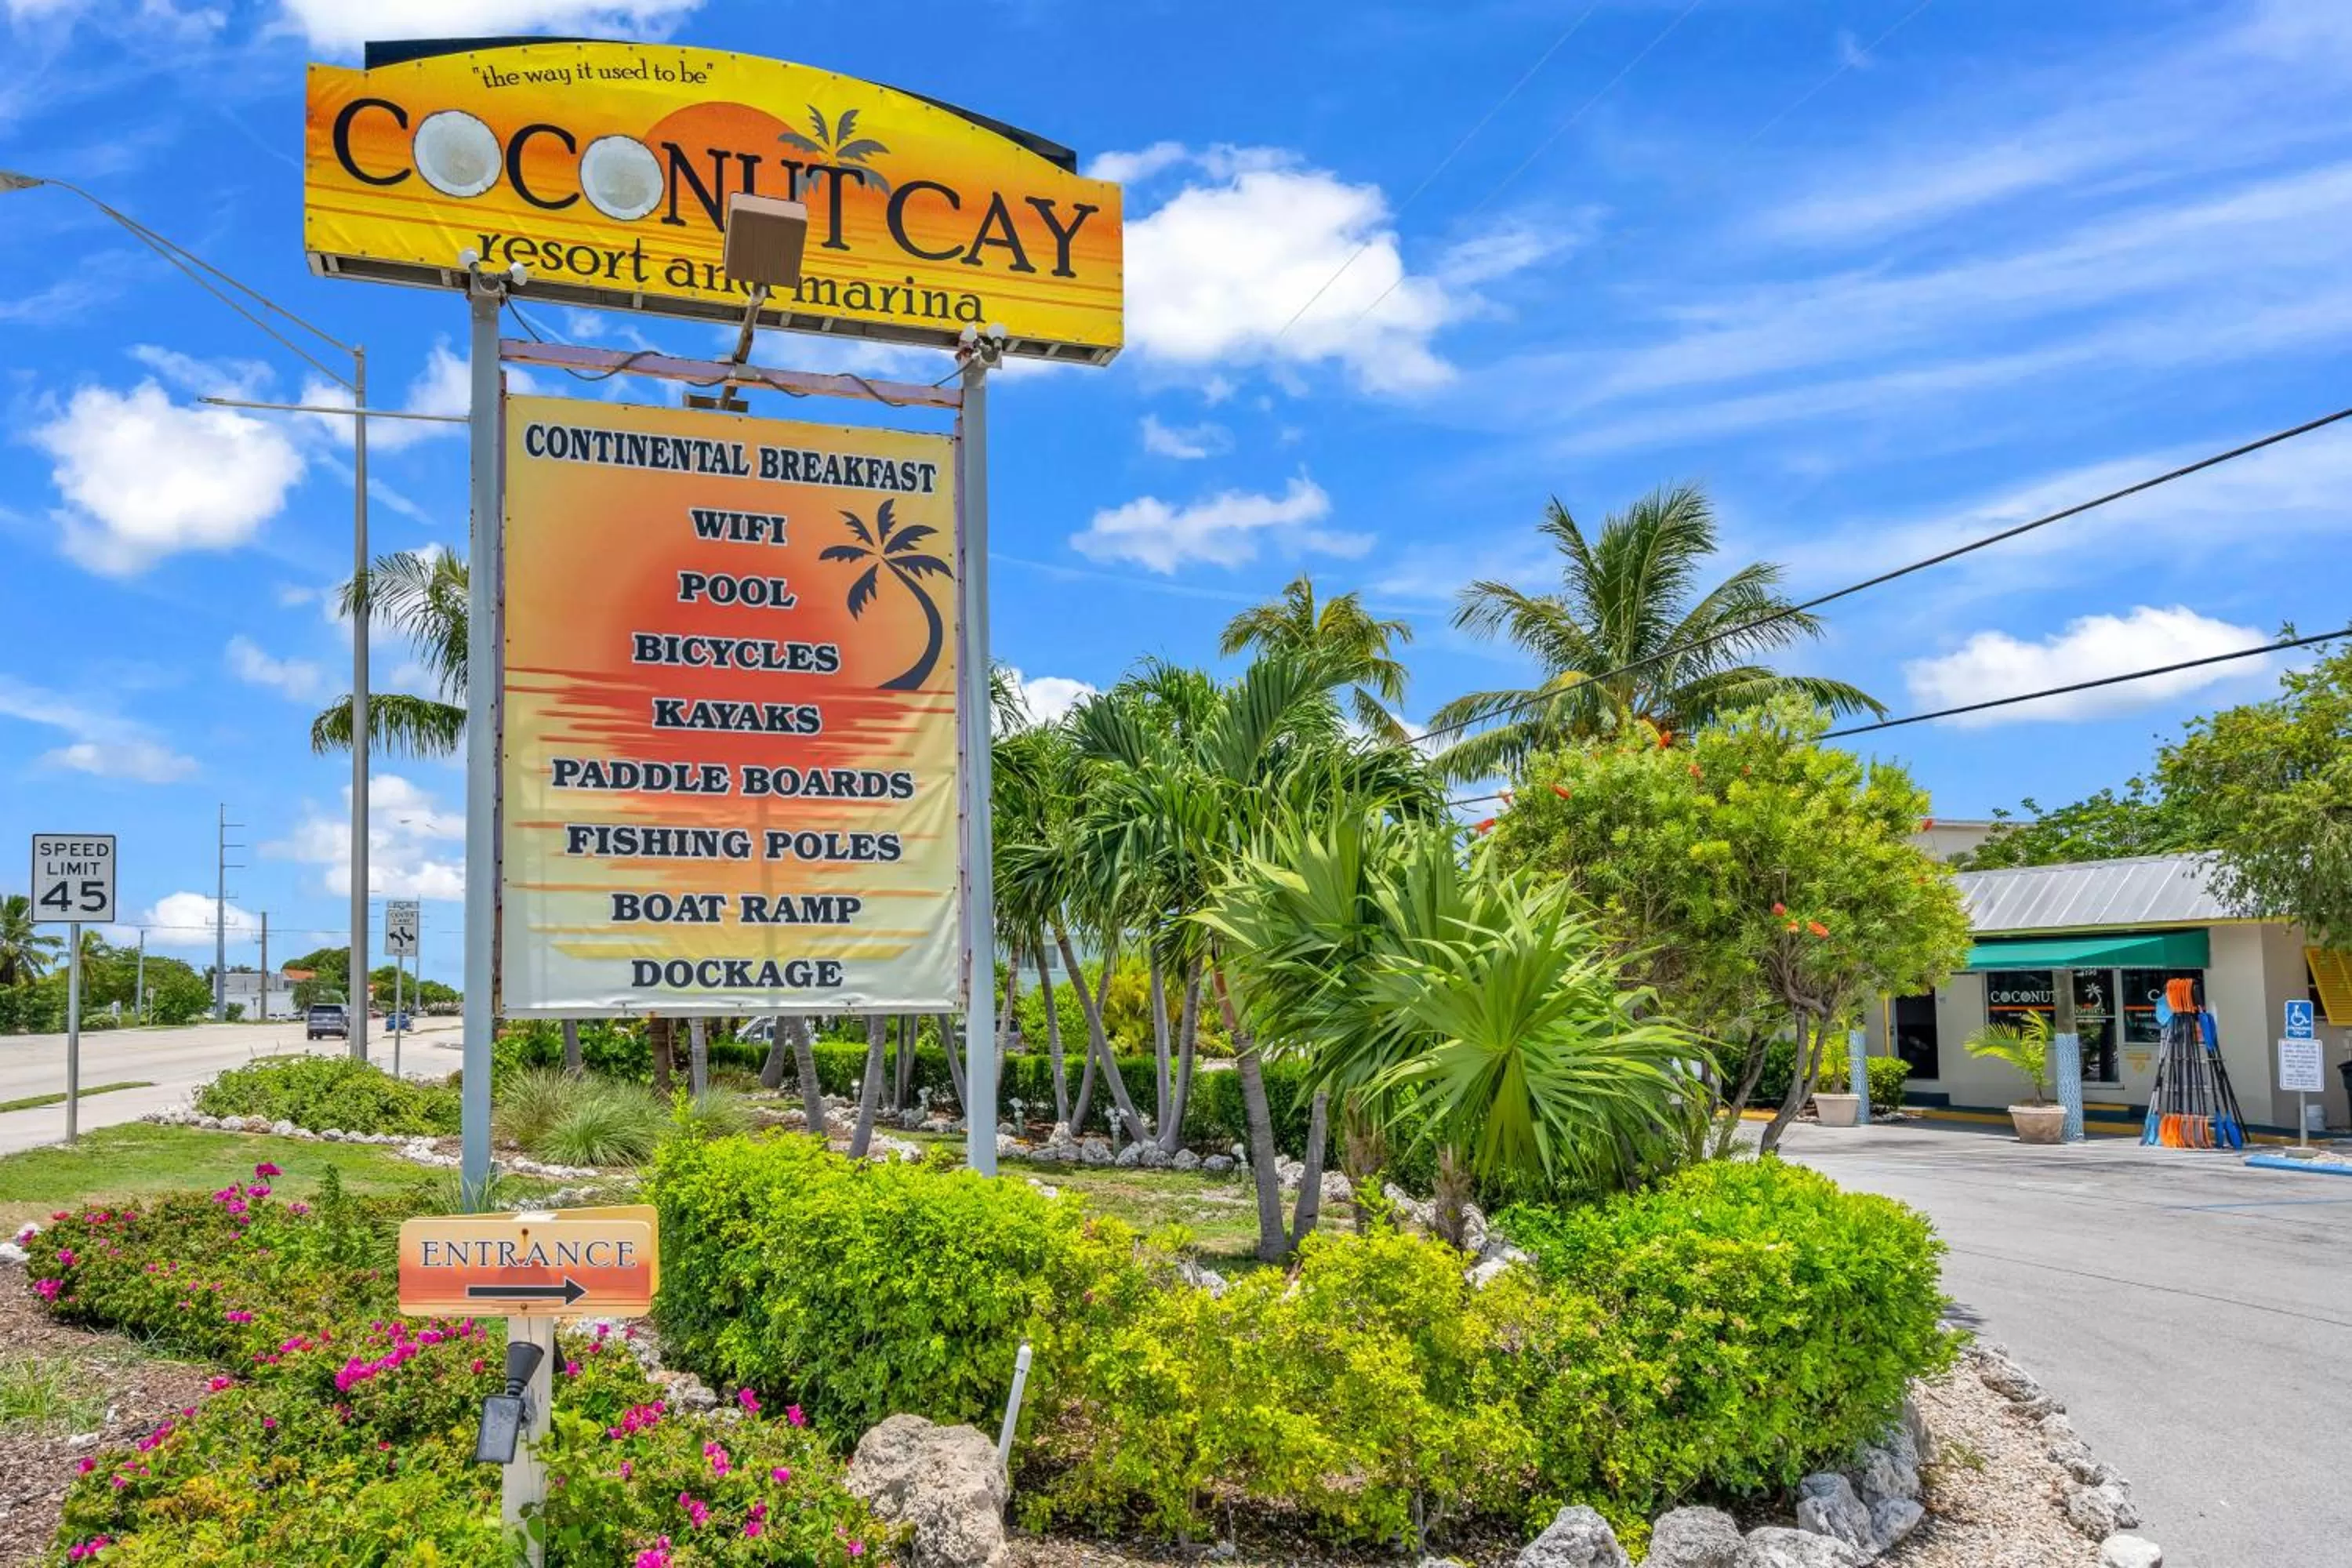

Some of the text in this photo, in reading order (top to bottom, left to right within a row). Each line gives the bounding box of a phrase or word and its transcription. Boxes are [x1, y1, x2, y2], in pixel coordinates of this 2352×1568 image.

[523, 64, 572, 85] way
[577, 63, 593, 79] it
[597, 58, 648, 80] used
[654, 64, 675, 82] to
[887, 180, 1099, 278] CAY
[477, 233, 649, 283] resort
[792, 274, 986, 324] marina
[525, 423, 937, 494] CONTINENTAL BREAKFAST
[691, 509, 786, 544] WIFI
[678, 572, 797, 608] POOL
[633, 633, 840, 673] BICYCLES
[653, 699, 822, 735] KAYAKS
[552, 757, 915, 799] PADDLE BOARDS
[40, 843, 109, 856] SPEED
[566, 825, 902, 862] FISHING POLES
[48, 862, 100, 875] LIMIT
[40, 881, 107, 912] 45
[612, 892, 862, 924] BOAT RAMP
[631, 959, 844, 989] DOCKAGE
[421, 1240, 637, 1267] ENTRANCE
